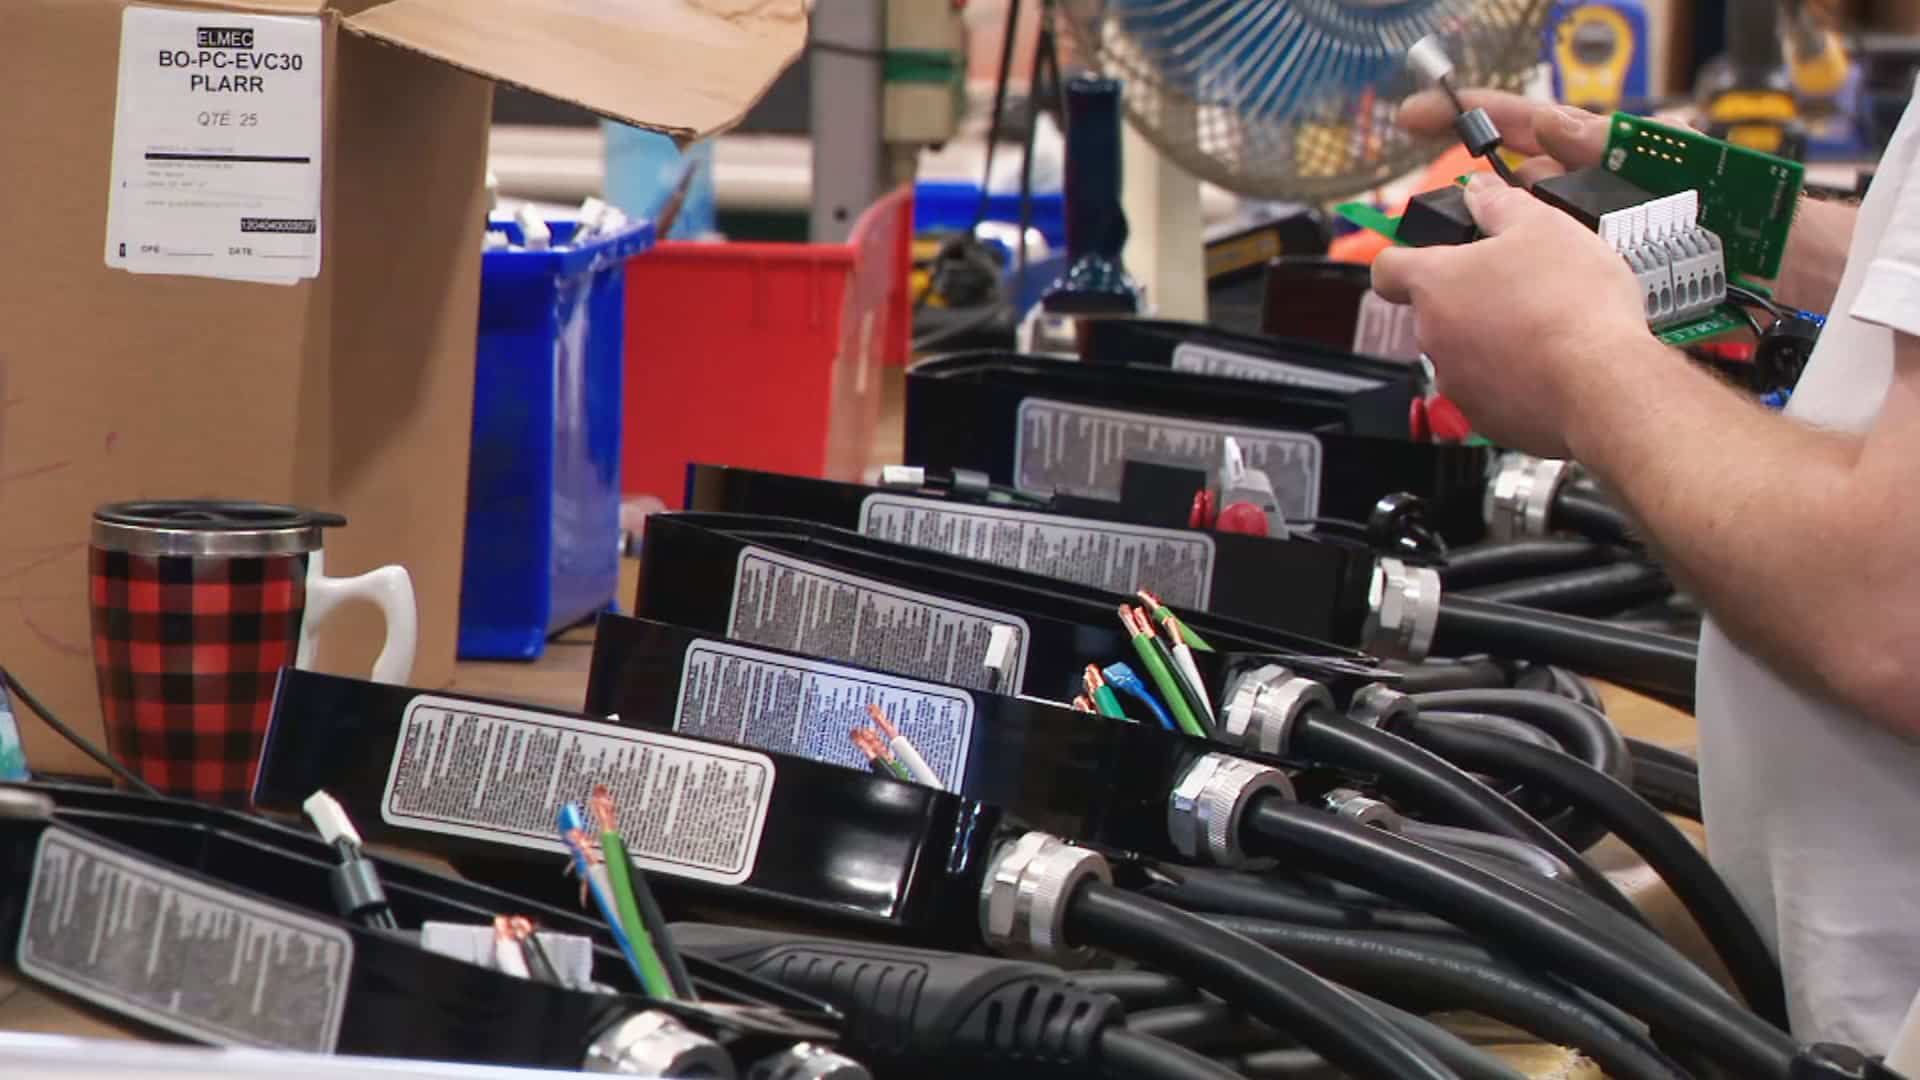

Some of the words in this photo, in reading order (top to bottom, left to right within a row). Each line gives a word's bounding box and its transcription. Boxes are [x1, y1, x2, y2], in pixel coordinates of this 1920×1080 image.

[198, 31, 253, 46] ELMEC
[159, 50, 303, 70] BO-PC-EVC30
[191, 75, 264, 92] PLARR
[239, 112, 258, 126] 25
[228, 247, 253, 256] DATE
